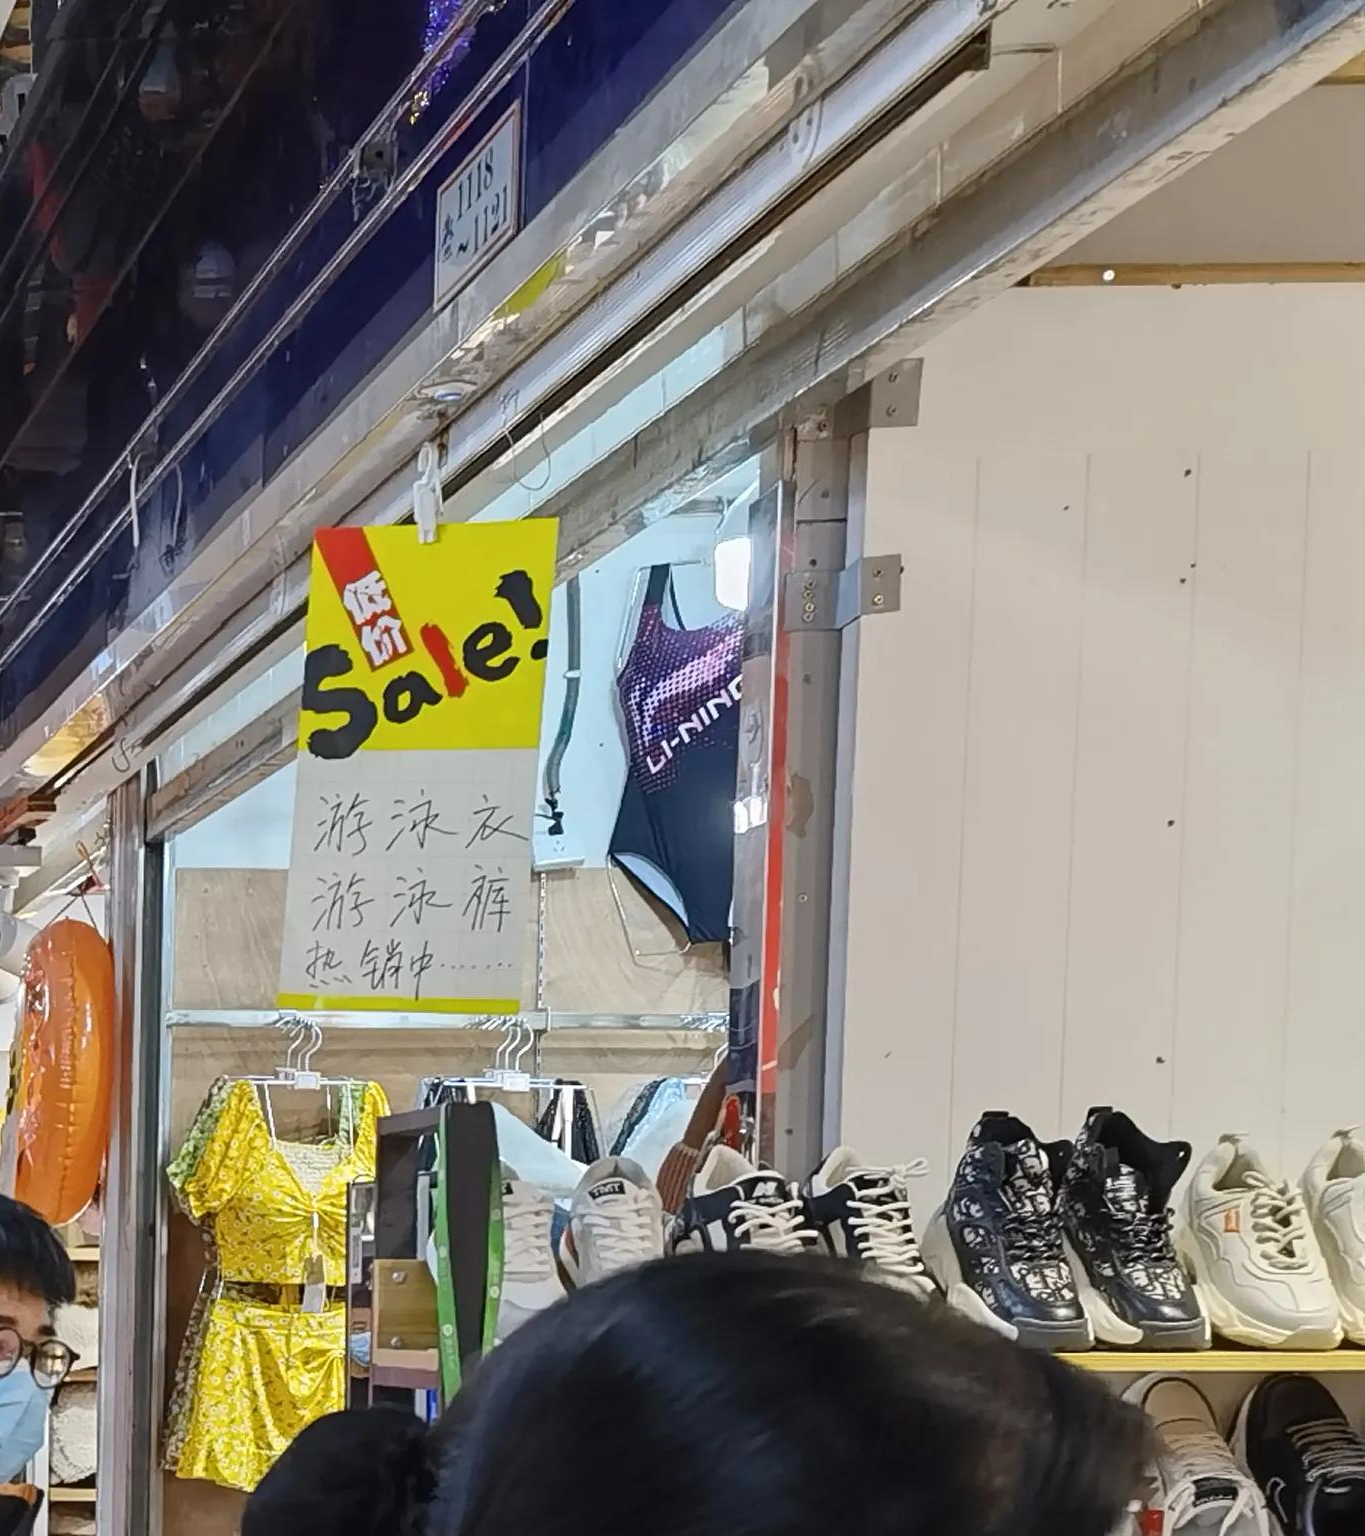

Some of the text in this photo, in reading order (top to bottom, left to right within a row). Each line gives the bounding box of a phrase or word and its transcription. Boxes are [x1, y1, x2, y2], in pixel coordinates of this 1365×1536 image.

[458, 148, 494, 220] 1118
[343, 568, 405, 667] 低价
[302, 568, 549, 760] Sale!
[313, 790, 530, 857] 游泳衣
[311, 864, 513, 932] 游泳裤
